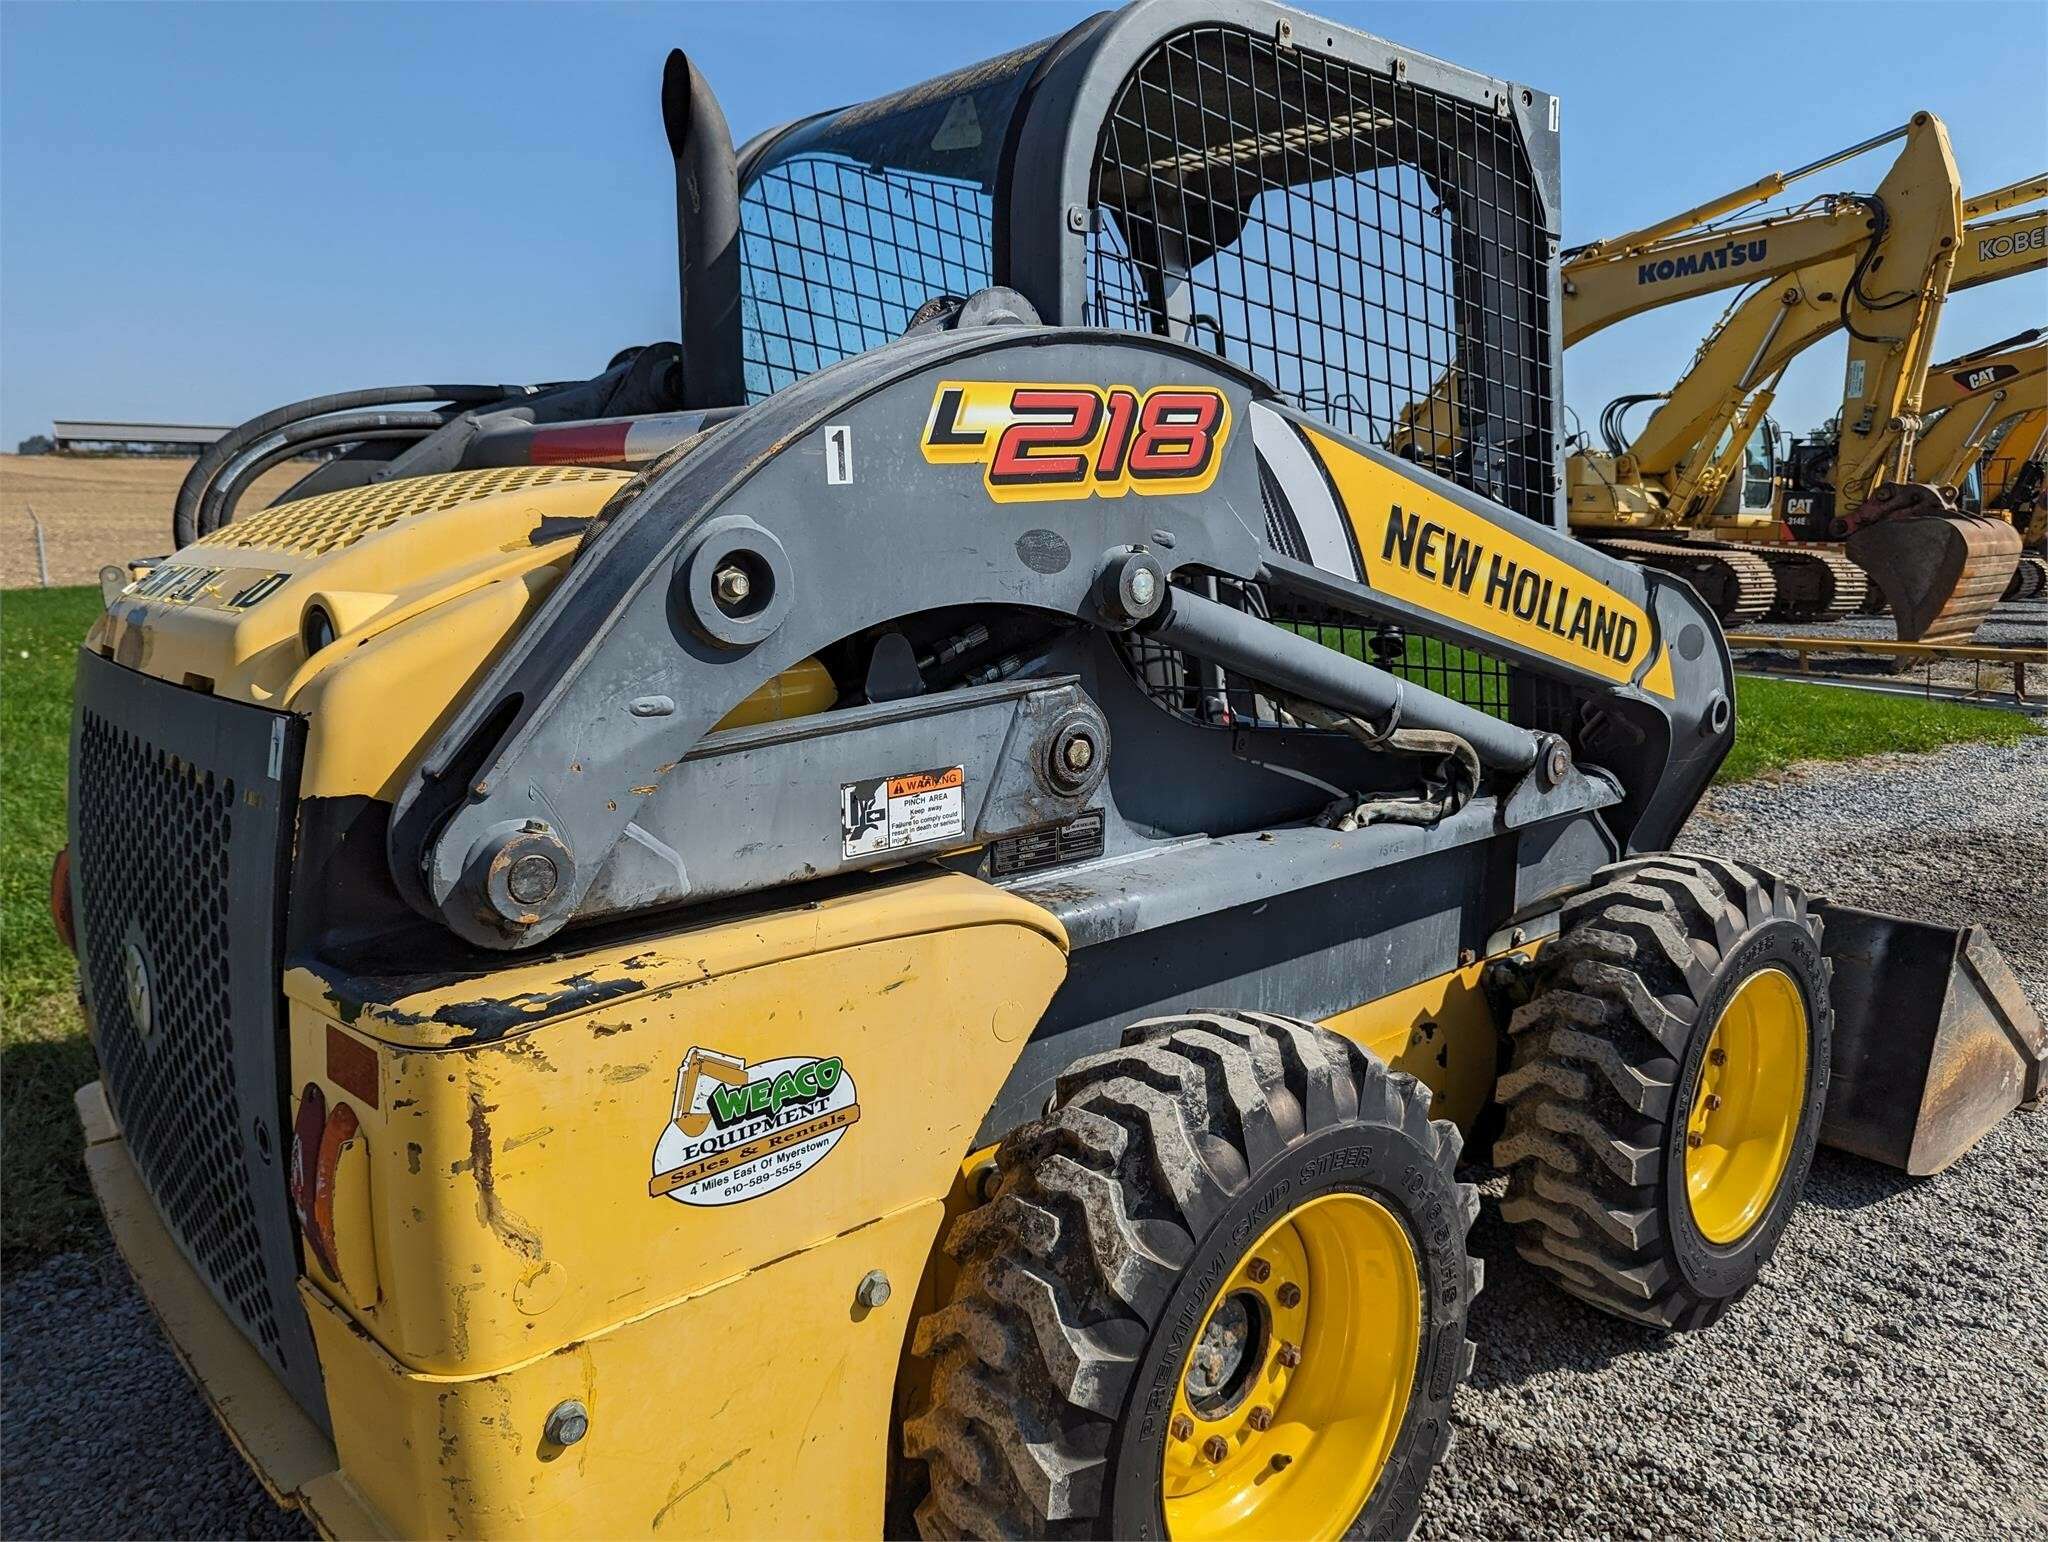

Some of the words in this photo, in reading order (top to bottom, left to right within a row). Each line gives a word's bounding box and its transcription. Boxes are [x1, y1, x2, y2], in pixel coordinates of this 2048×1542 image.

[1638, 239, 1767, 285] KOMATSU
[1968, 366, 1995, 389] CAT
[831, 429, 846, 482] 1
[926, 387, 1229, 486] L218
[1787, 498, 1814, 514] CAT
[1380, 503, 1483, 596] NEW
[1483, 552, 1639, 665] HOLLAND
[891, 821, 912, 830] Failure
[920, 814, 942, 826] comply
[942, 811, 958, 819] could
[904, 796, 926, 807] PINCH
[929, 793, 948, 802] AREA
[910, 807, 925, 817] Keep
[892, 828, 909, 836] result
[916, 823, 933, 832] death
[709, 1057, 843, 1128] WEACO
[671, 1156, 730, 1185] Sales
[740, 1146, 759, 1159] &
[768, 1113, 847, 1149] Rentals
[682, 1097, 831, 1162] EQUIPMENT
[690, 1185, 698, 1196] 4
[702, 1175, 730, 1193] Miles
[733, 1164, 758, 1180] East
[760, 1157, 774, 1169] Of
[776, 1137, 830, 1165] Myerstown
[724, 1160, 803, 1197] 610-589-5555
[1232, 1178, 1290, 1246] SKID
[1300, 1145, 1374, 1186] STEER
